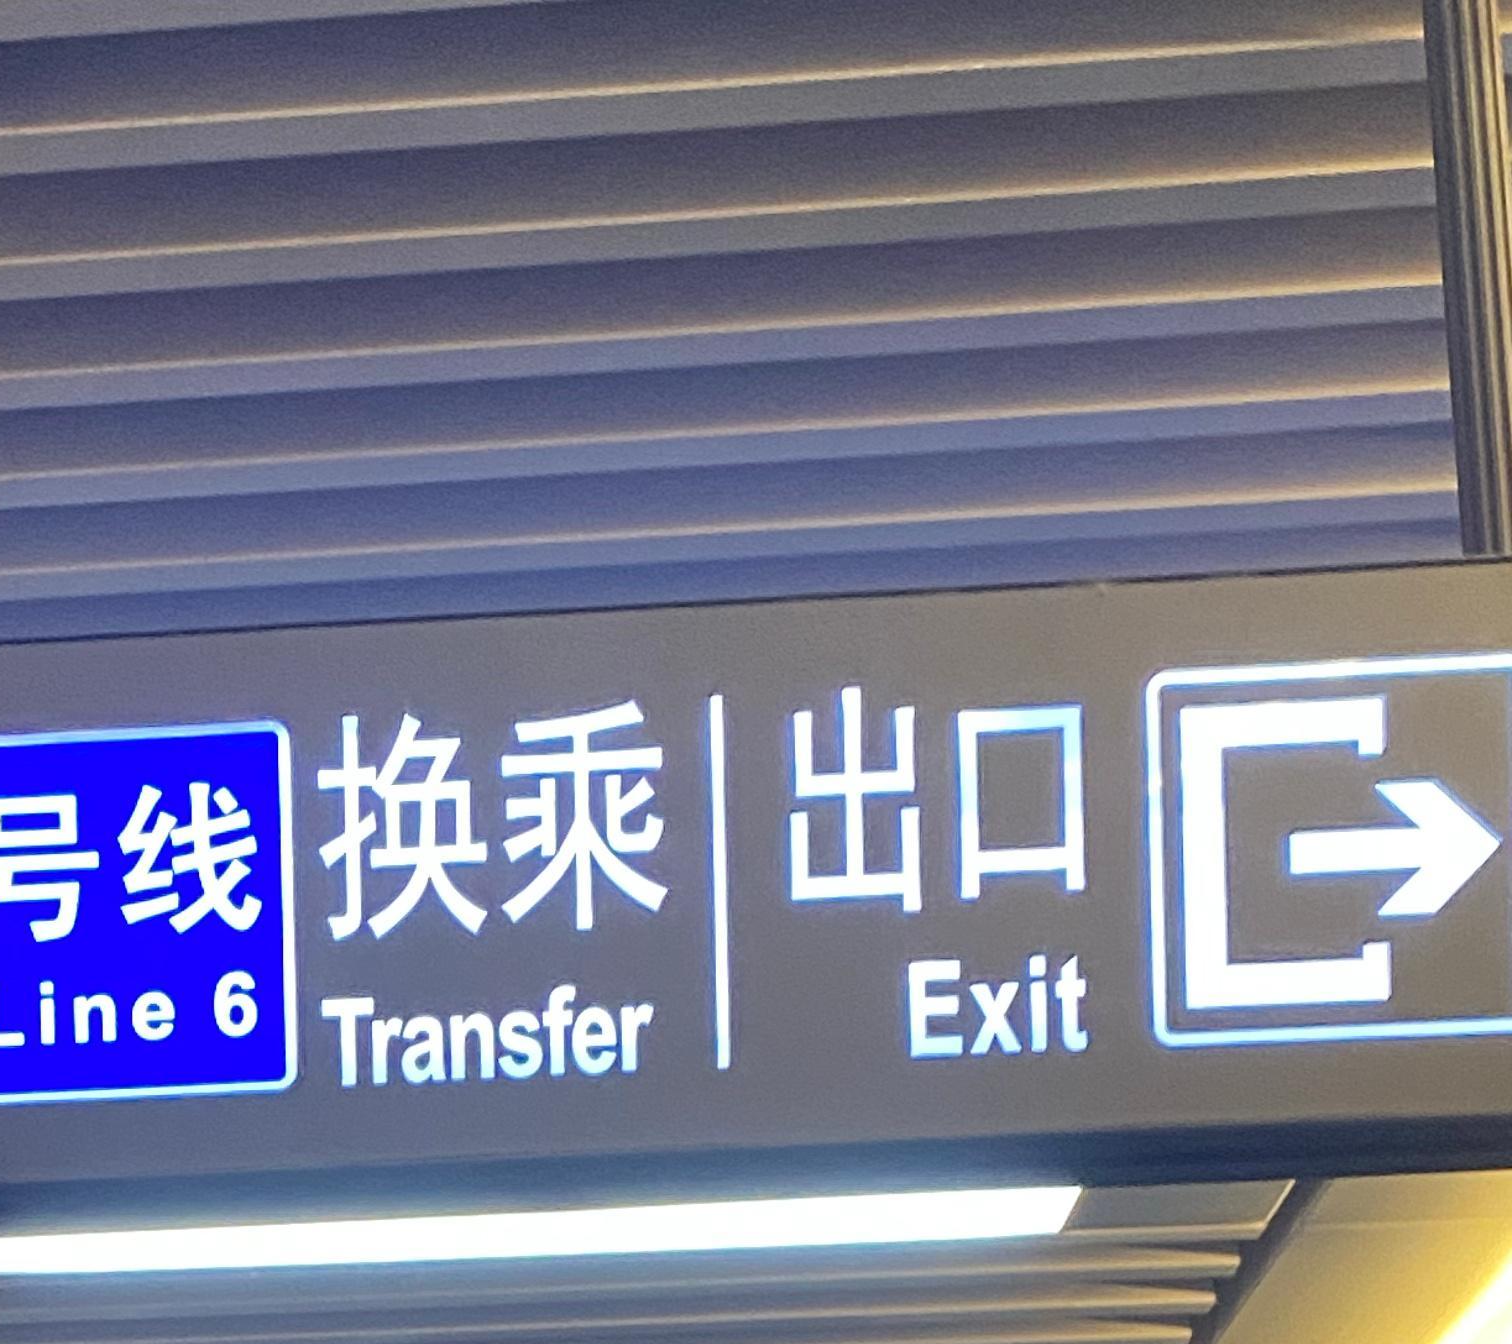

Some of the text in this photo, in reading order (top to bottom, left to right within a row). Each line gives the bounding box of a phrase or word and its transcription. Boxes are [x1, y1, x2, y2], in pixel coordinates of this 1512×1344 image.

[316, 698, 670, 941] 换乘
[789, 686, 1088, 914] 出口
[213, 970, 258, 1038] 6
[320, 983, 655, 1087] Transfer
[907, 954, 1088, 1057] Exit
